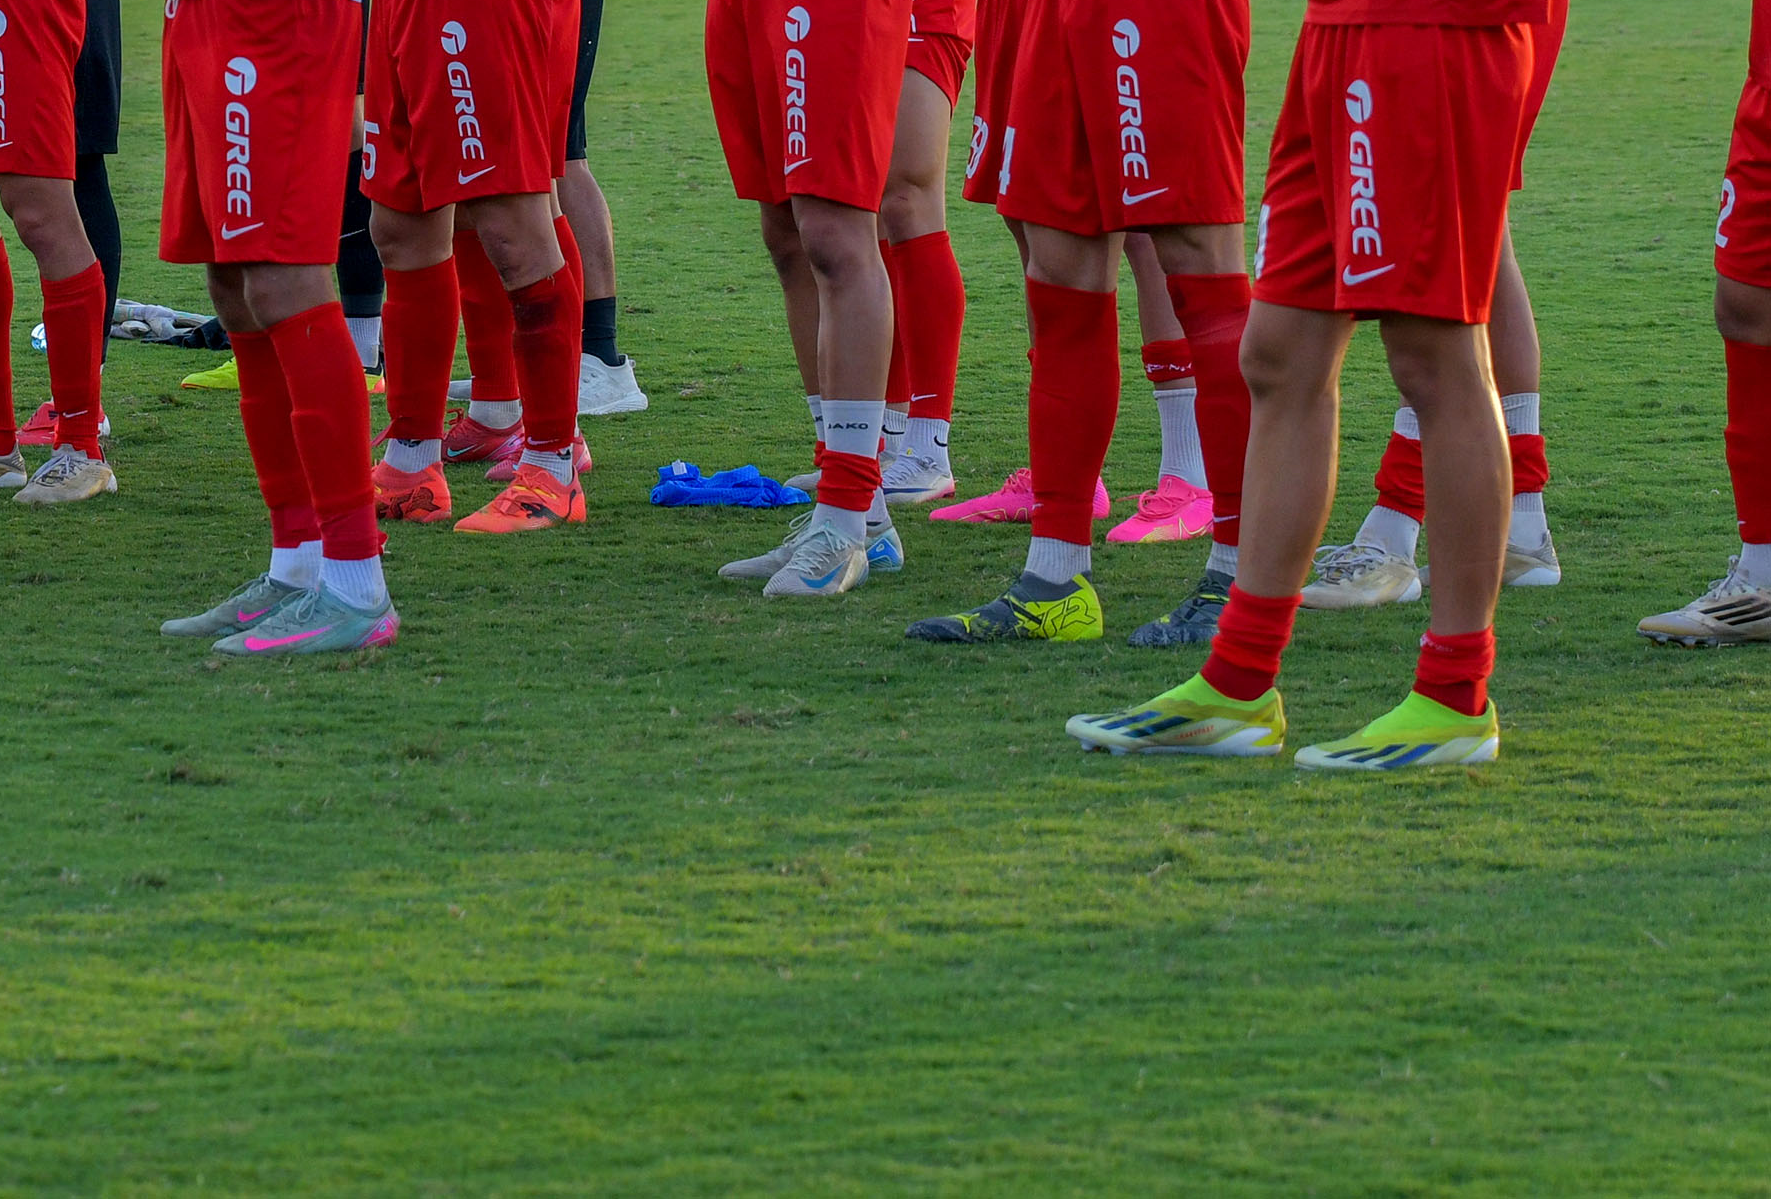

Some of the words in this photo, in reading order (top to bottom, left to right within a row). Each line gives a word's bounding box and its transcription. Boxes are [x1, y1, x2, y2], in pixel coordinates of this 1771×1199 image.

[447, 61, 484, 161] GREE
[784, 48, 807, 157] GREE
[1116, 64, 1150, 180] GREE
[225, 102, 252, 218] GREE
[1349, 130, 1383, 257] GREE
[828, 422, 869, 430] JAKO
